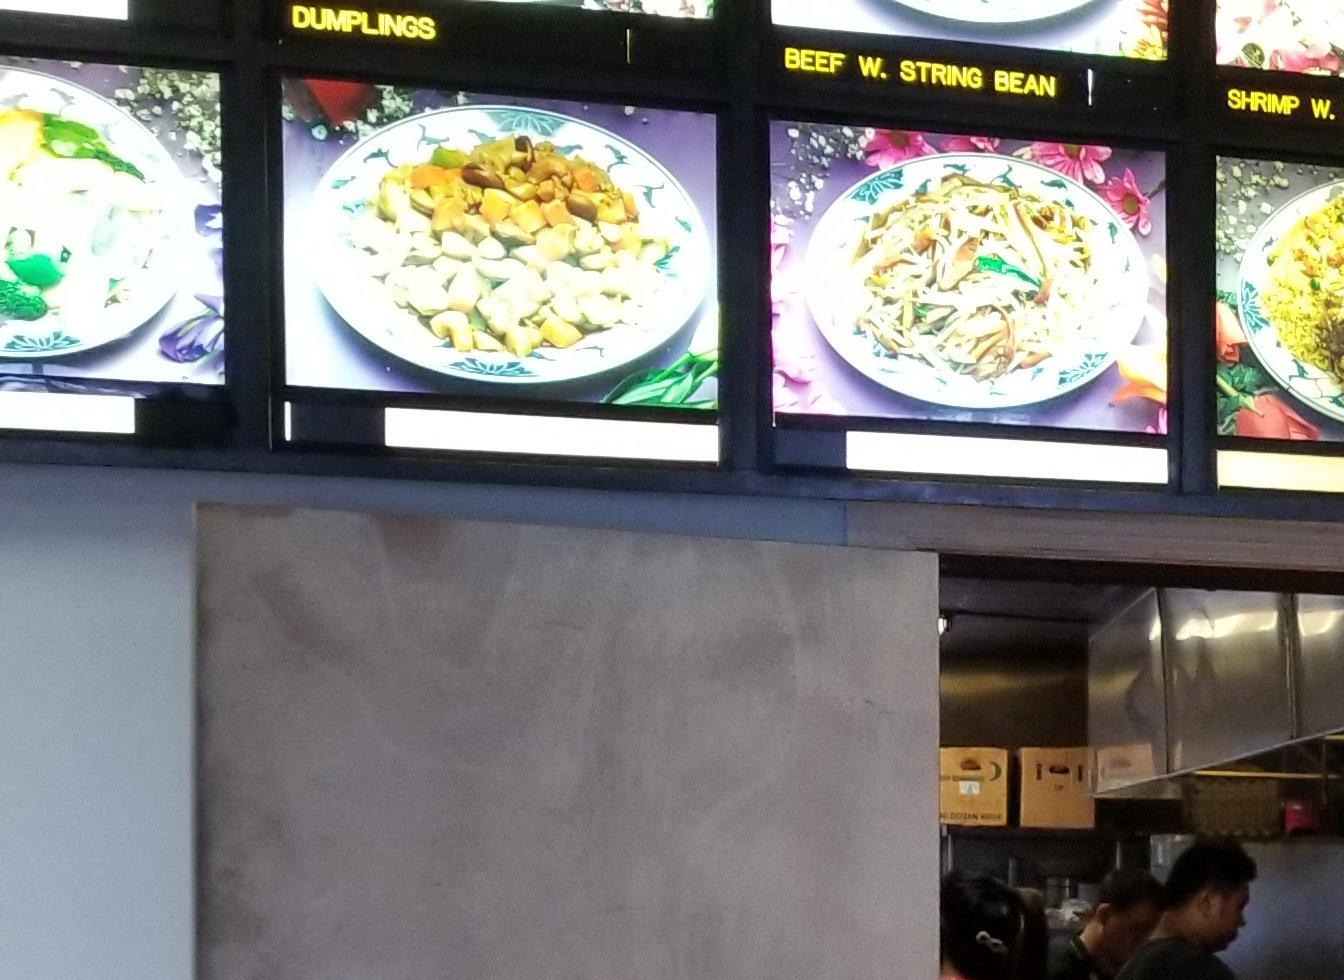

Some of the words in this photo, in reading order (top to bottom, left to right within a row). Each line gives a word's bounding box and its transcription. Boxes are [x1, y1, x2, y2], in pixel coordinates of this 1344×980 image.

[292, 5, 436, 39] DUMPLINGS
[785, 48, 845, 73] BEEF
[859, 55, 887, 79] W.
[900, 60, 983, 89] STRING
[994, 70, 1056, 98] BEAN
[1227, 88, 1300, 115] SHRIMP
[1311, 98, 1335, 121] W.
